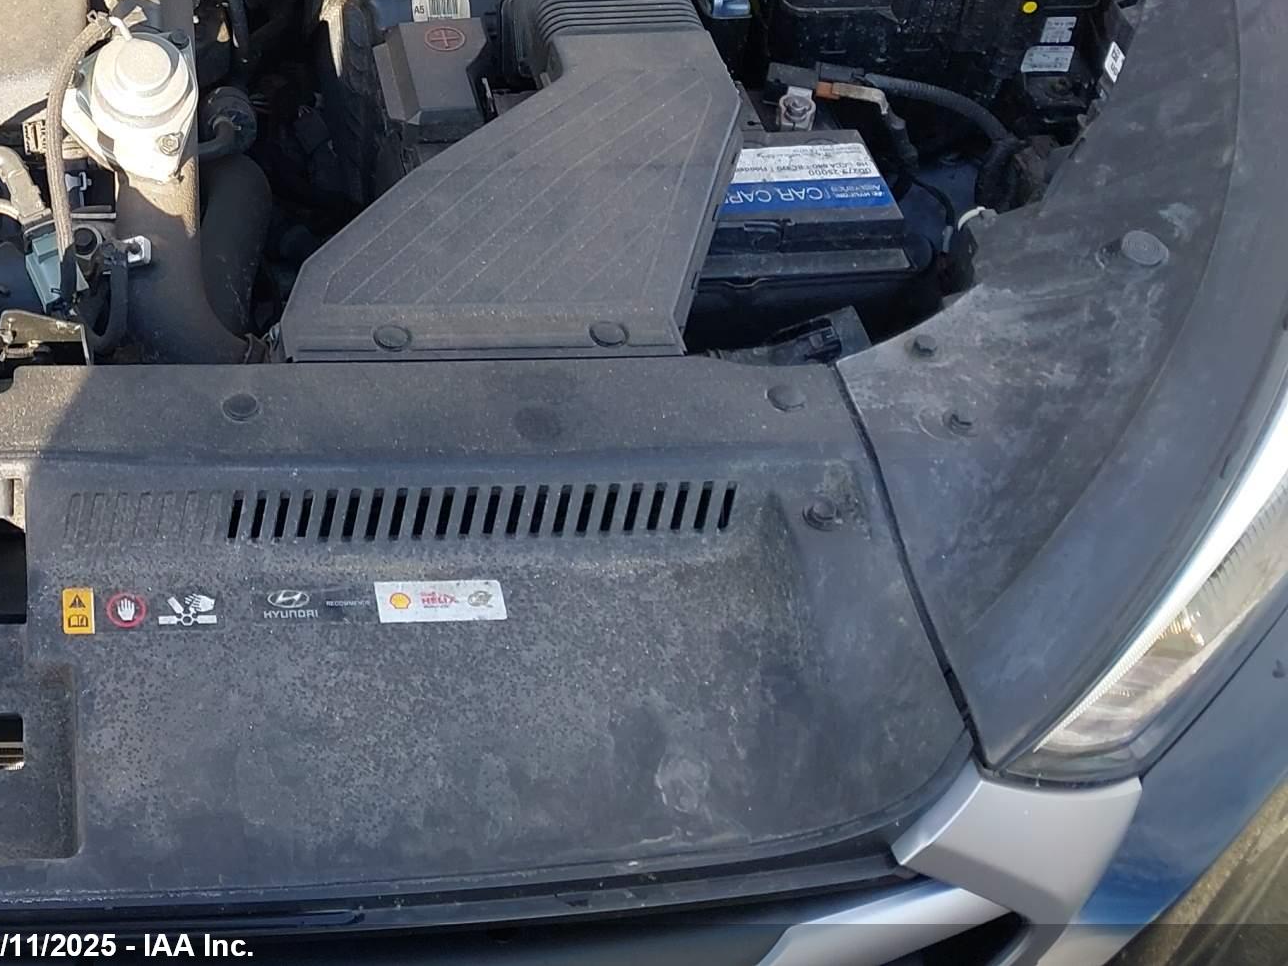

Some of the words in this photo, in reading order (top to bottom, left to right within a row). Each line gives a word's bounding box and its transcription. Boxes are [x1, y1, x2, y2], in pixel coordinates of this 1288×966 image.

[778, 187, 823, 201] CAR
[421, 594, 457, 604] HELIX
[264, 609, 319, 619] HYUNDAI
